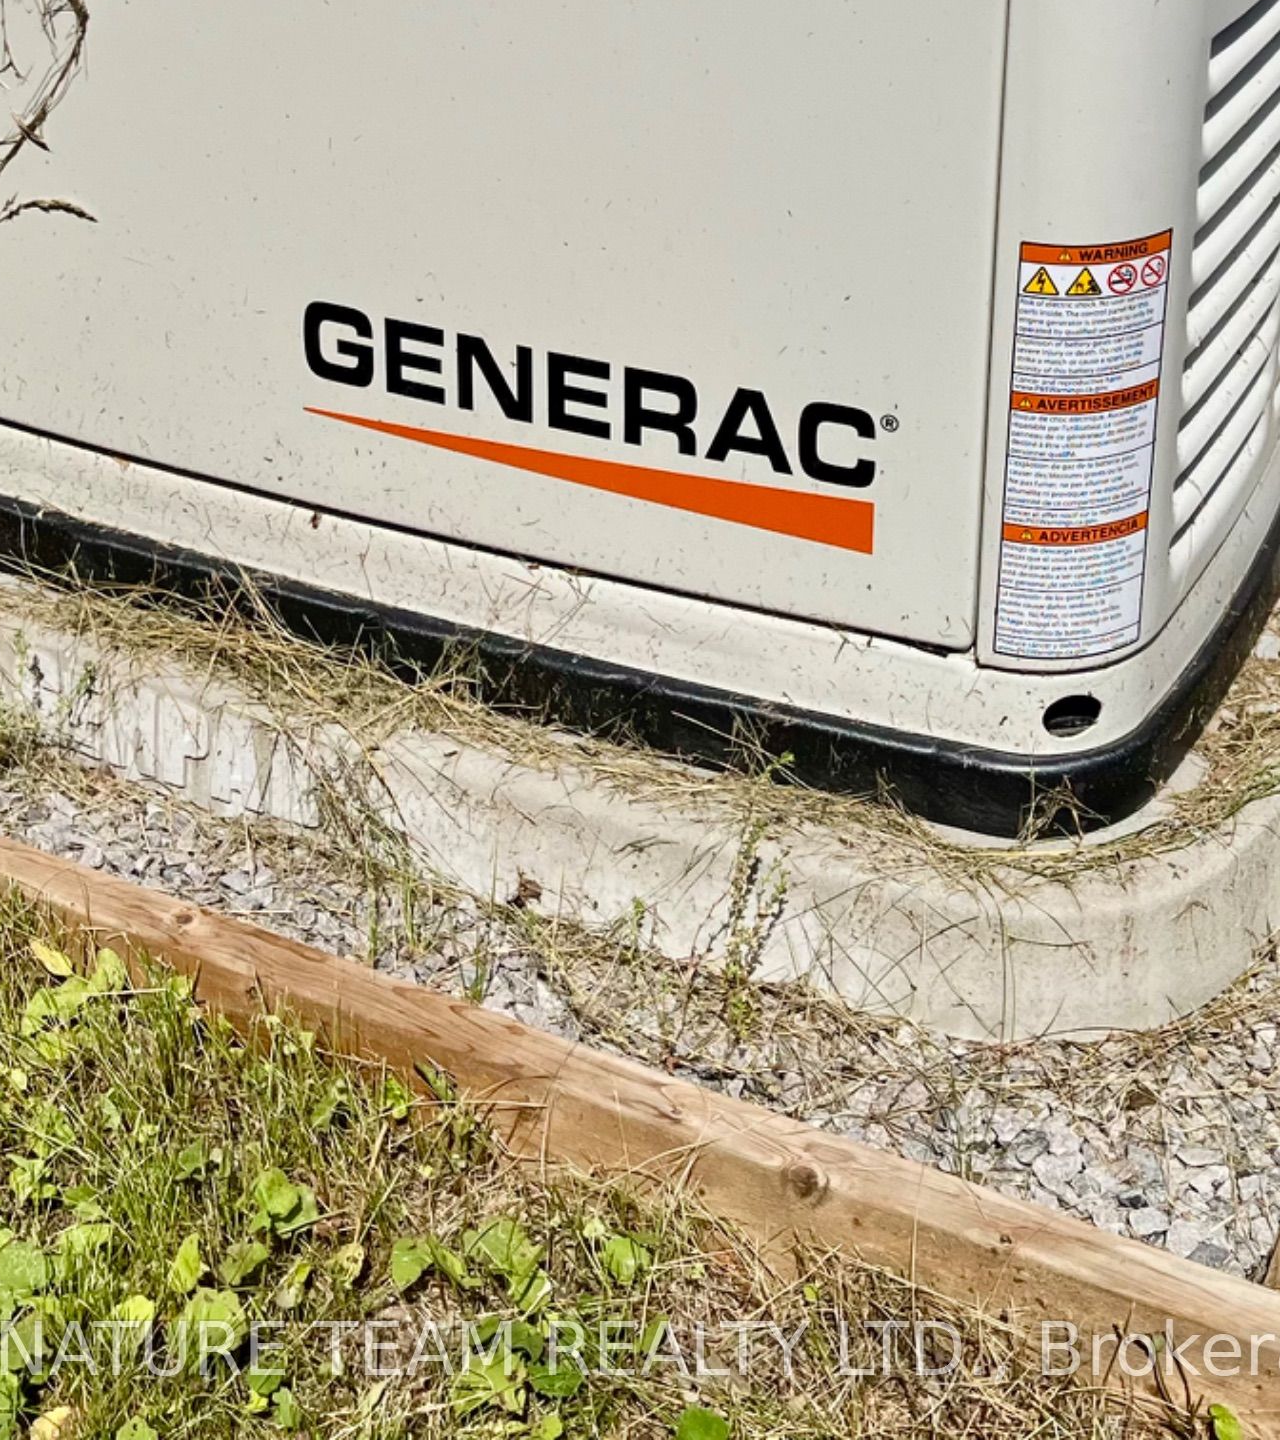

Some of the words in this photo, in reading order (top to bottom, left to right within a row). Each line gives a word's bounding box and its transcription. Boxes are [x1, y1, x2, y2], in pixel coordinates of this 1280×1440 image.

[1079, 242, 1147, 261] WARNING
[1036, 384, 1155, 410] AVERTISSEMENT
[1039, 519, 1138, 542] ADVERTENCIA
